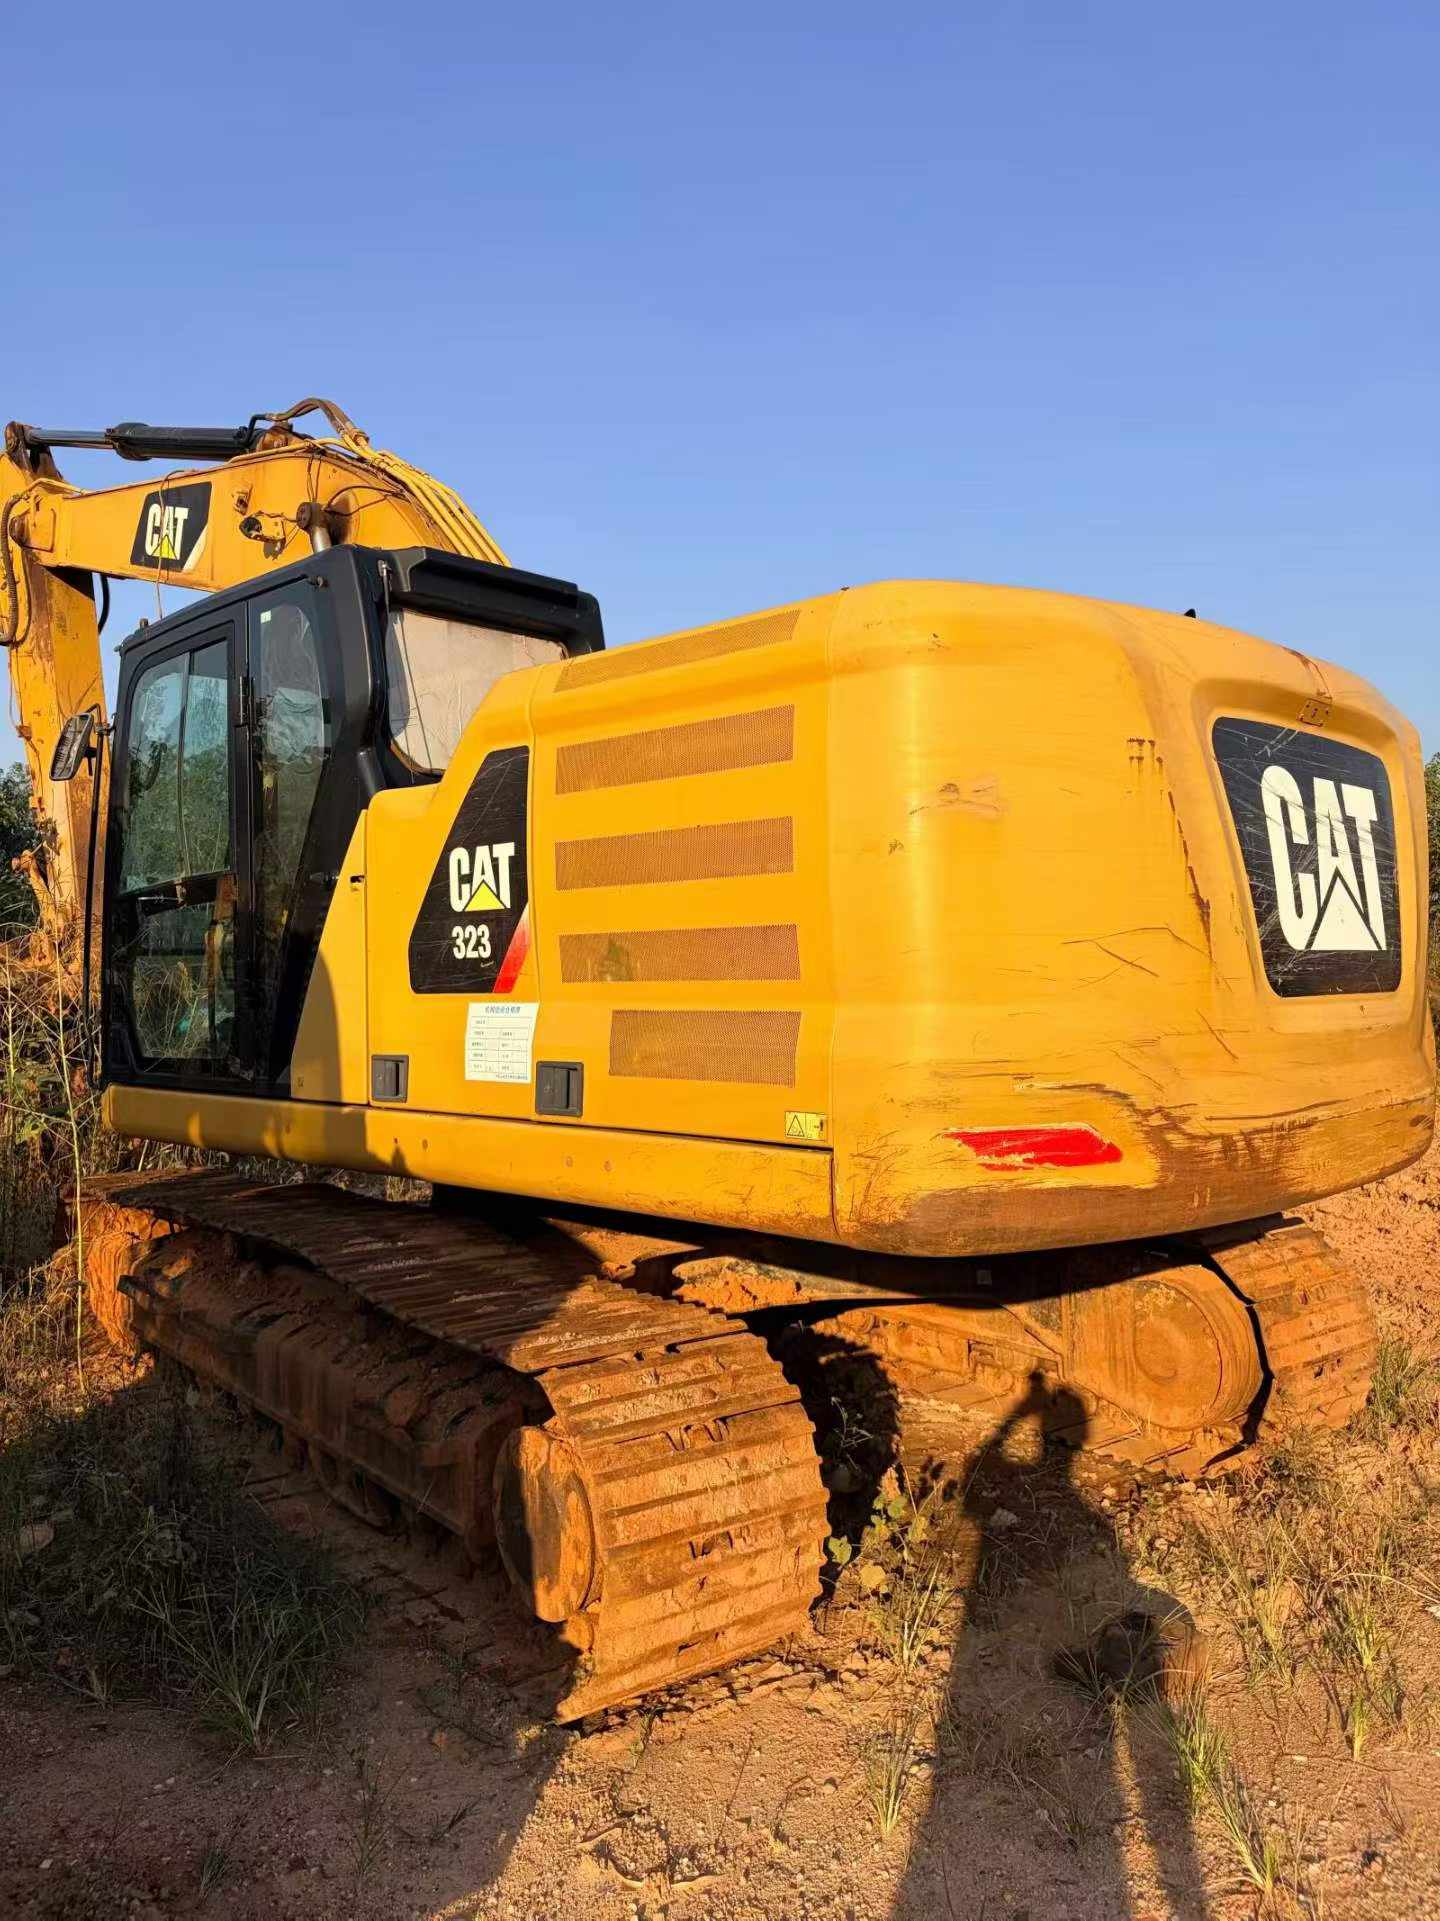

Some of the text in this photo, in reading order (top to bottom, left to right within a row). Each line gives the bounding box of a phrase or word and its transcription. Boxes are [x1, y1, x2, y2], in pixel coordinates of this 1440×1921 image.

[145, 503, 189, 560] CAT
[449, 842, 515, 912] CAT
[1261, 765, 1387, 951] CAT
[452, 924, 491, 960] 323
